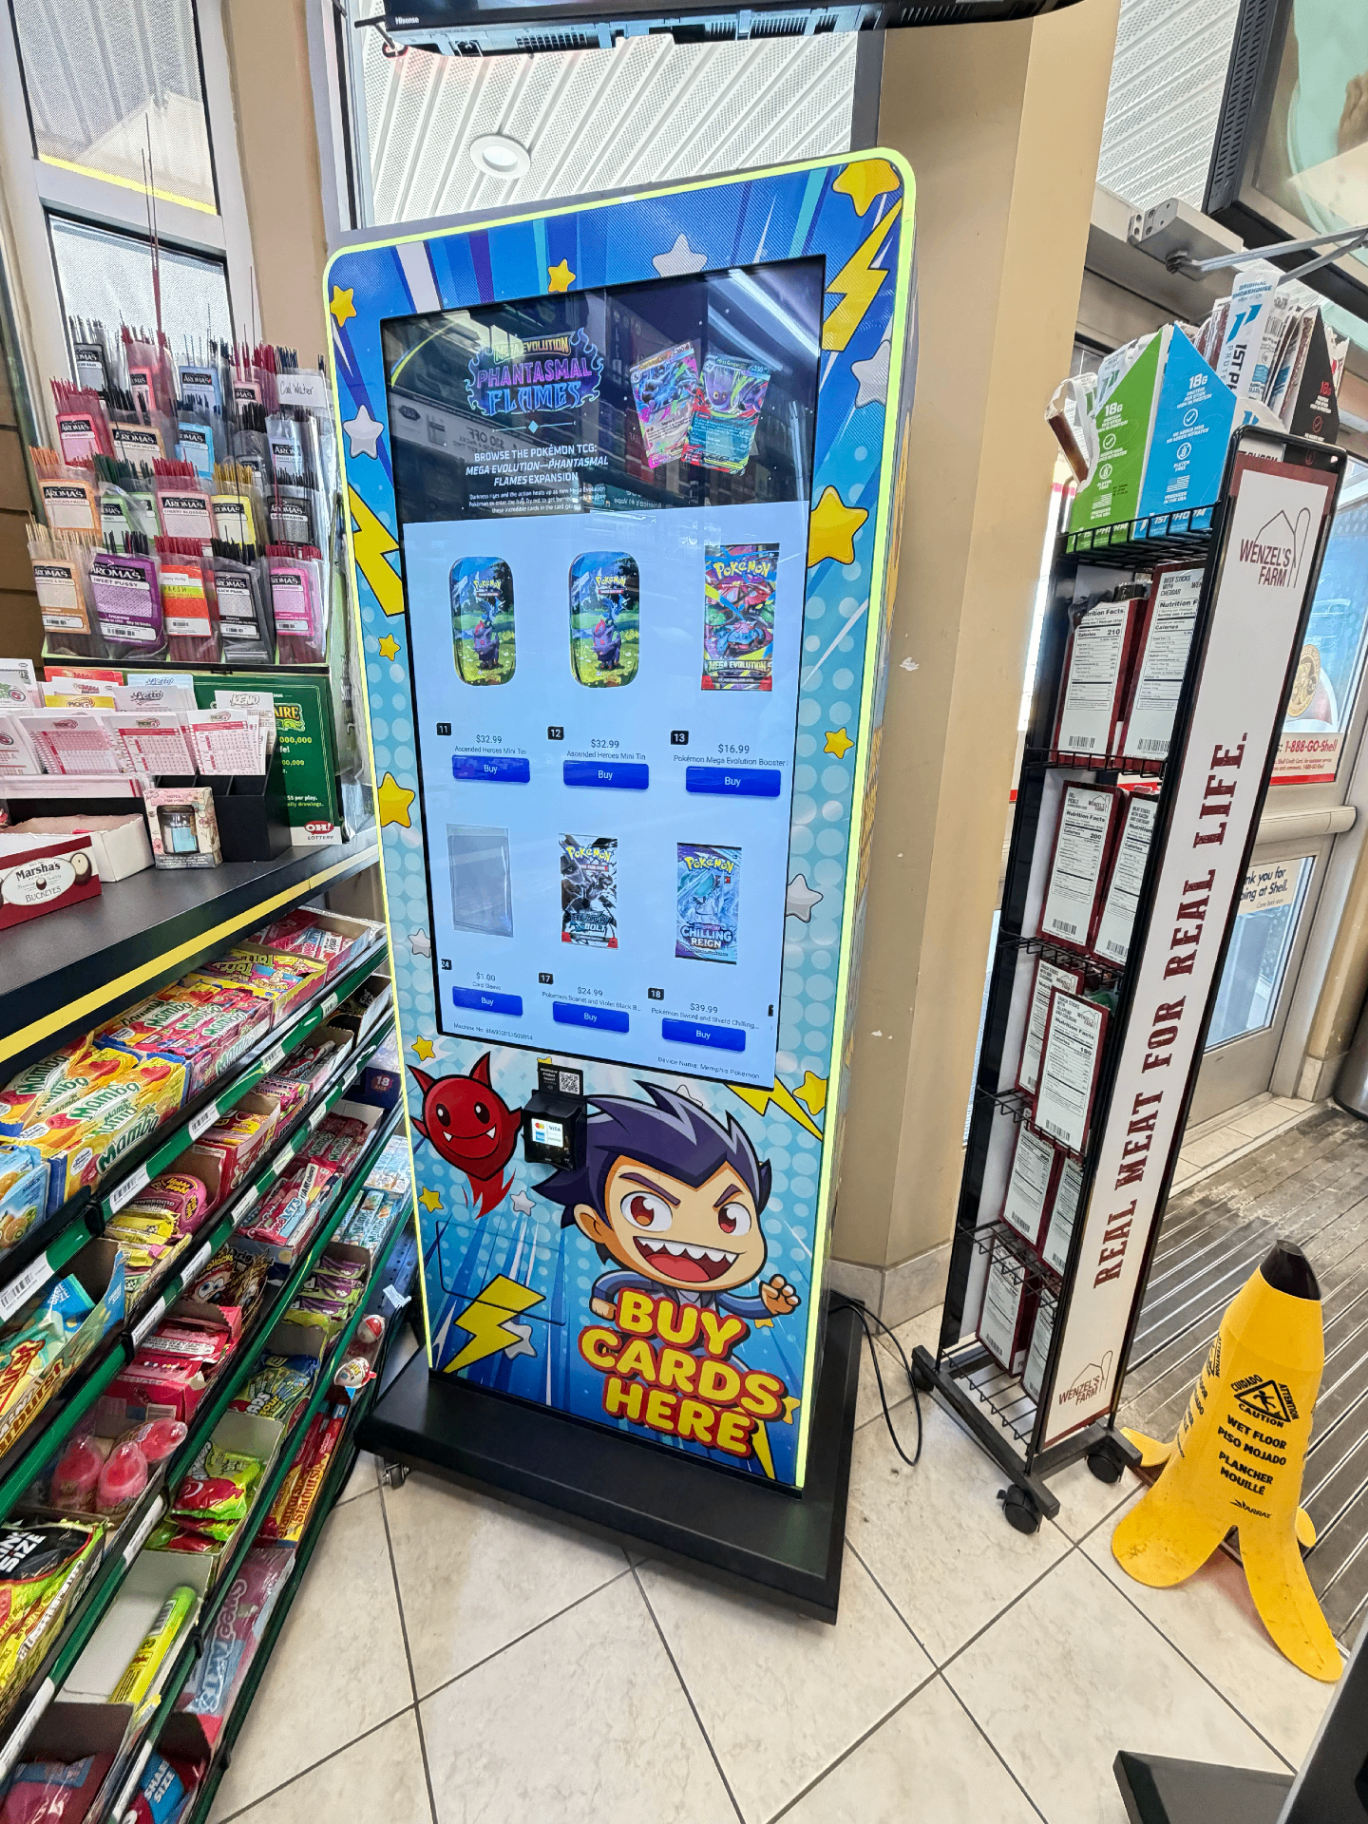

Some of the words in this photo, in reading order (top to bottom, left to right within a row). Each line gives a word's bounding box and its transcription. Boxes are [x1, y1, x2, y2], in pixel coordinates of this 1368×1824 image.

[523, 337, 571, 354] EVOLUTION
[476, 357, 592, 389] PHANTASMAL
[486, 381, 582, 416] FLAMES
[115, 431, 154, 443] AROMAS
[474, 449, 510, 462] BROWSE
[511, 449, 529, 459] THE
[530, 444, 575, 459] POKÉMON
[576, 443, 597, 454] TCG:
[465, 465, 490, 476] MEGA
[493, 476, 527, 487] FLAMES
[529, 471, 579, 485] EXPANSION
[45, 489, 84, 498] AROMAS
[164, 499, 205, 509] AROMAS
[1240, 538, 1292, 567] WENZEL'S
[91, 566, 141, 580] AROMAS
[1258, 566, 1288, 587] FARM
[1159, 600, 1191, 609] Nutrition
[476, 734, 502, 744] $32.99
[550, 729, 561, 738] 12
[674, 733, 685, 743] 13
[591, 739, 619, 749] $32.99
[718, 744, 750, 754] $16.99
[1285, 739, 1338, 754] 1-888-GO-Shell
[566, 750, 596, 758] Ascended
[673, 754, 705, 763] Pokémon
[706, 756, 725, 765] Mega
[726, 757, 757, 765] Evolution
[758, 758, 786, 767] Booster
[483, 764, 498, 775] Buy
[598, 769, 613, 781] Buy
[724, 776, 741, 788] Buy
[1194, 731, 1248, 848] LIFE.
[1066, 810, 1089, 820] Nutrition
[1090, 814, 1106, 823] Facts
[305, 823, 332, 832] OH!
[15, 862, 61, 881] Marsha's
[1258, 870, 1274, 886] you
[1275, 866, 1287, 879] for
[25, 886, 62, 902] BUCKEYES
[1259, 886, 1269, 897] at
[1270, 880, 1288, 895] Shell.
[1164, 868, 1215, 980] REAL
[680, 927, 734, 942] CHILLING
[691, 937, 721, 948] REIGN
[540, 974, 551, 982] 17
[577, 986, 603, 997] $24.99
[651, 990, 661, 998] 18
[481, 997, 494, 1007] Buy
[690, 1002, 718, 1013] $39.99
[145, 1001, 194, 1029] Mamba
[584, 1012, 597, 1023] Buy
[651, 1007, 678, 1017] Pokémon
[680, 1011, 698, 1020] Sword
[712, 1016, 730, 1024] Shield
[696, 1029, 711, 1040] Buy
[1142, 995, 1188, 1074] FOR
[15, 1055, 69, 1094] Mamba
[376, 1075, 390, 1086] 18
[69, 1081, 141, 1120] Mamba
[97, 1114, 160, 1174] Mamba
[1114, 1090, 1164, 1191] MEAT
[1093, 1199, 1137, 1289] REAL
[617, 1289, 744, 1358] BUY
[580, 1326, 783, 1416] CARDS
[1058, 1376, 1100, 1406] WENZEL'S
[1230, 1374, 1263, 1392] CUIDADO
[1076, 1385, 1101, 1406] FARM
[1278, 1382, 1300, 1420] ATTENTION
[603, 1376, 752, 1454] HERE
[1238, 1403, 1284, 1428] CAUTION
[1227, 1414, 1252, 1437] WET
[1252, 1429, 1287, 1451] FLOOR
[1217, 1425, 1241, 1448] PISO
[1243, 1442, 1287, 1466] MOJADO
[1219, 1451, 1273, 1485] PLANCHER
[1220, 1466, 1266, 1496] MOUILLÉ
[0, 1535, 47, 1573] SIZE
[154, 1771, 176, 1803] SIZE
